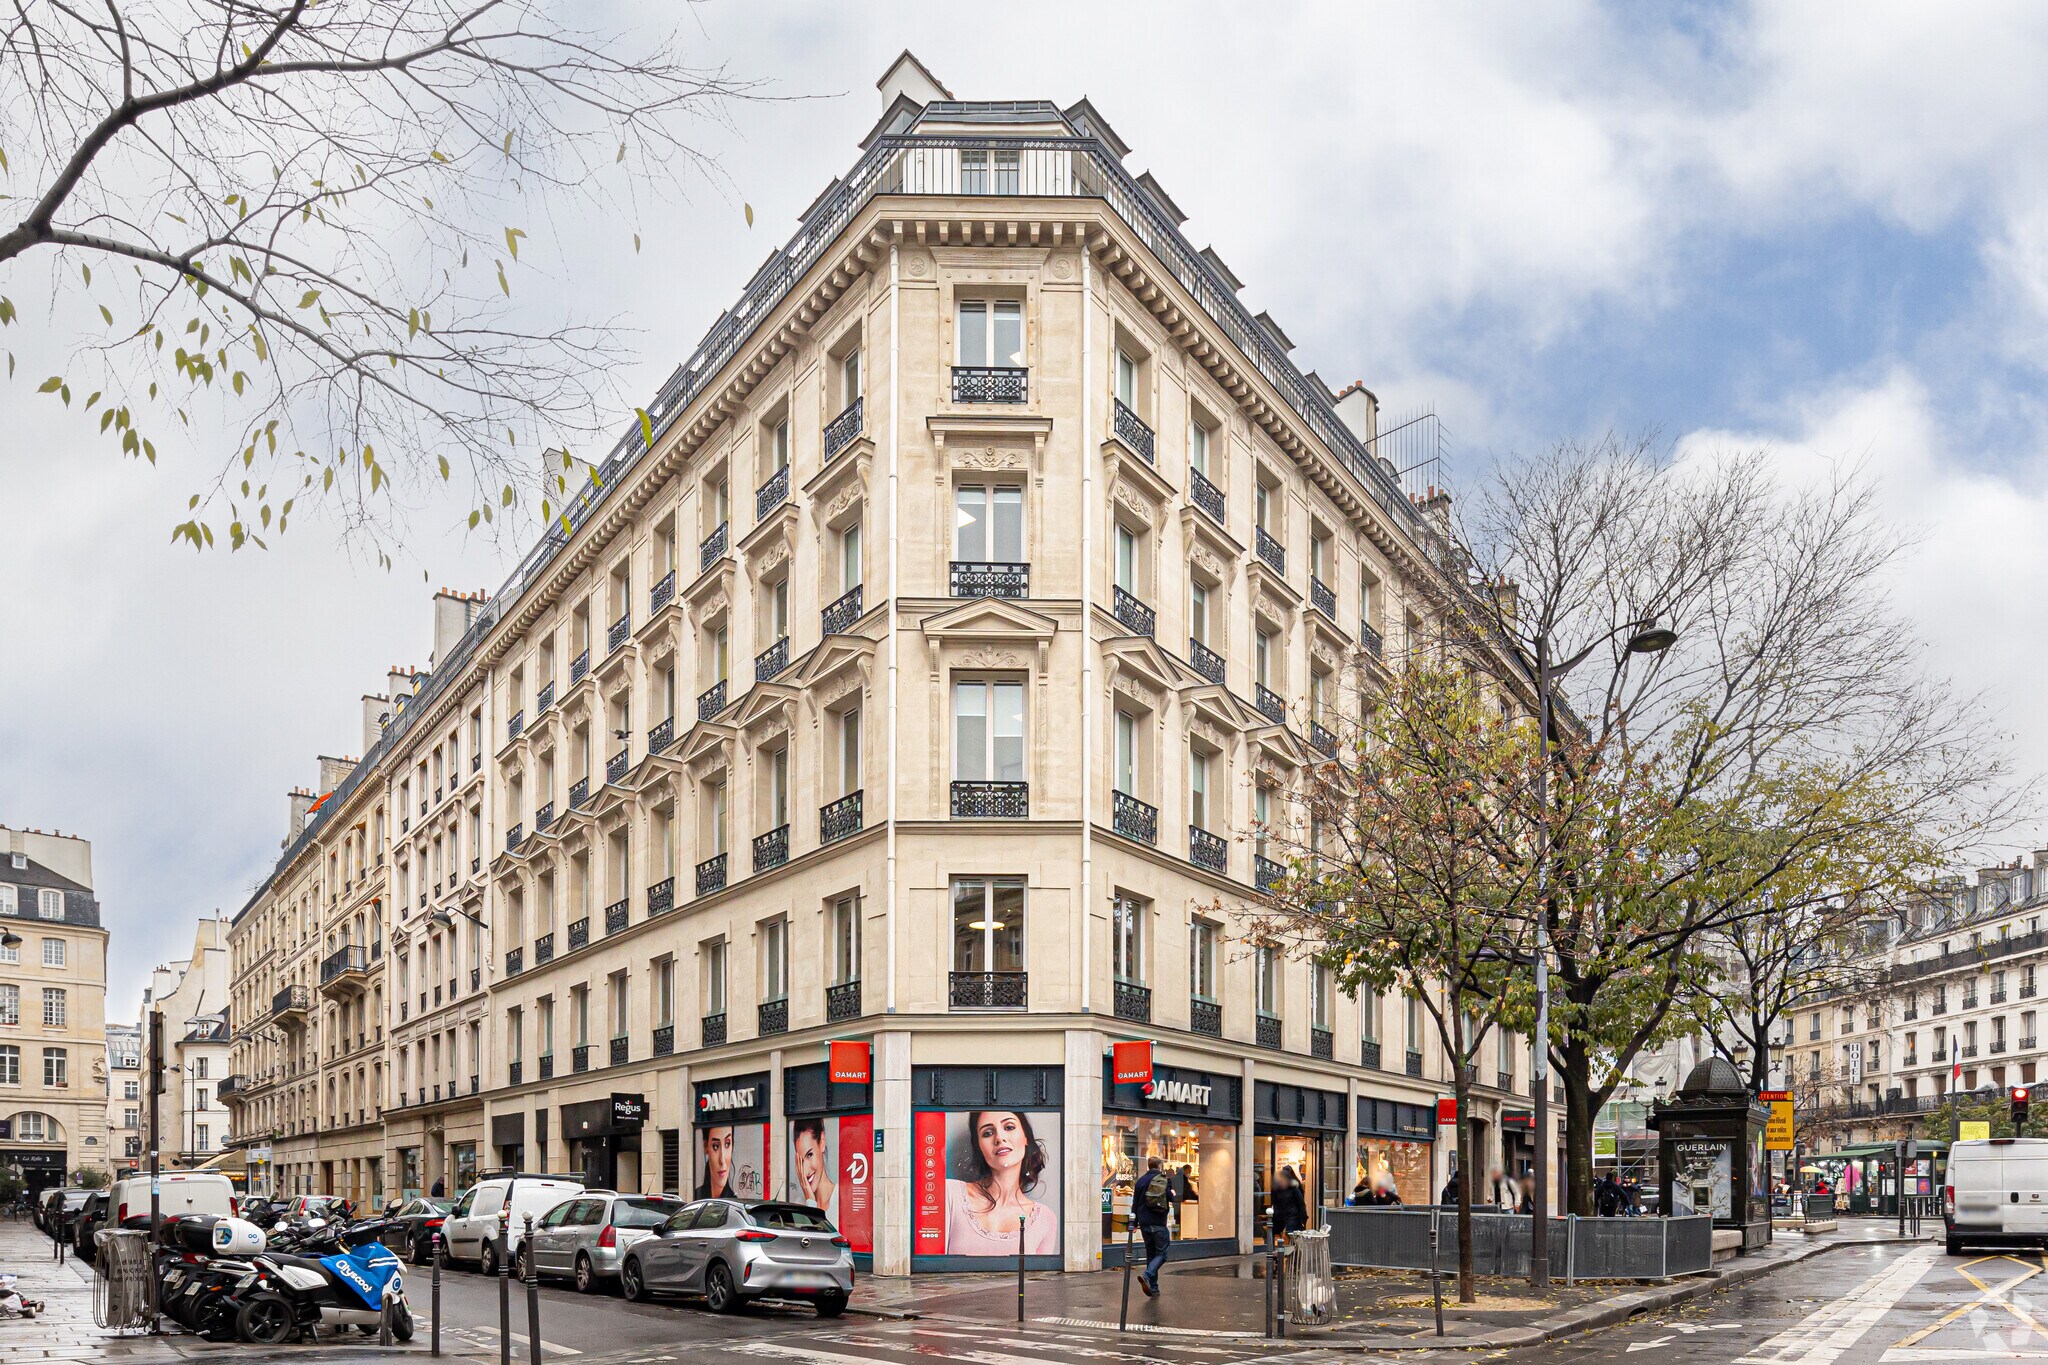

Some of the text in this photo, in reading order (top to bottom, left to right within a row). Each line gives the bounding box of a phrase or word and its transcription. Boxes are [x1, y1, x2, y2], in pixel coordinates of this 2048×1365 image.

[1851, 1044, 1859, 1083] HOTEL
[835, 1071, 867, 1079] DAMART
[1118, 1071, 1149, 1080] DAMART
[701, 1087, 756, 1112] DAMART
[1142, 1079, 1212, 1106] DAMART
[615, 1102, 641, 1115] Regus
[1677, 1143, 1726, 1151] GUERLAIN
[335, 1259, 374, 1294] Cityscoot
